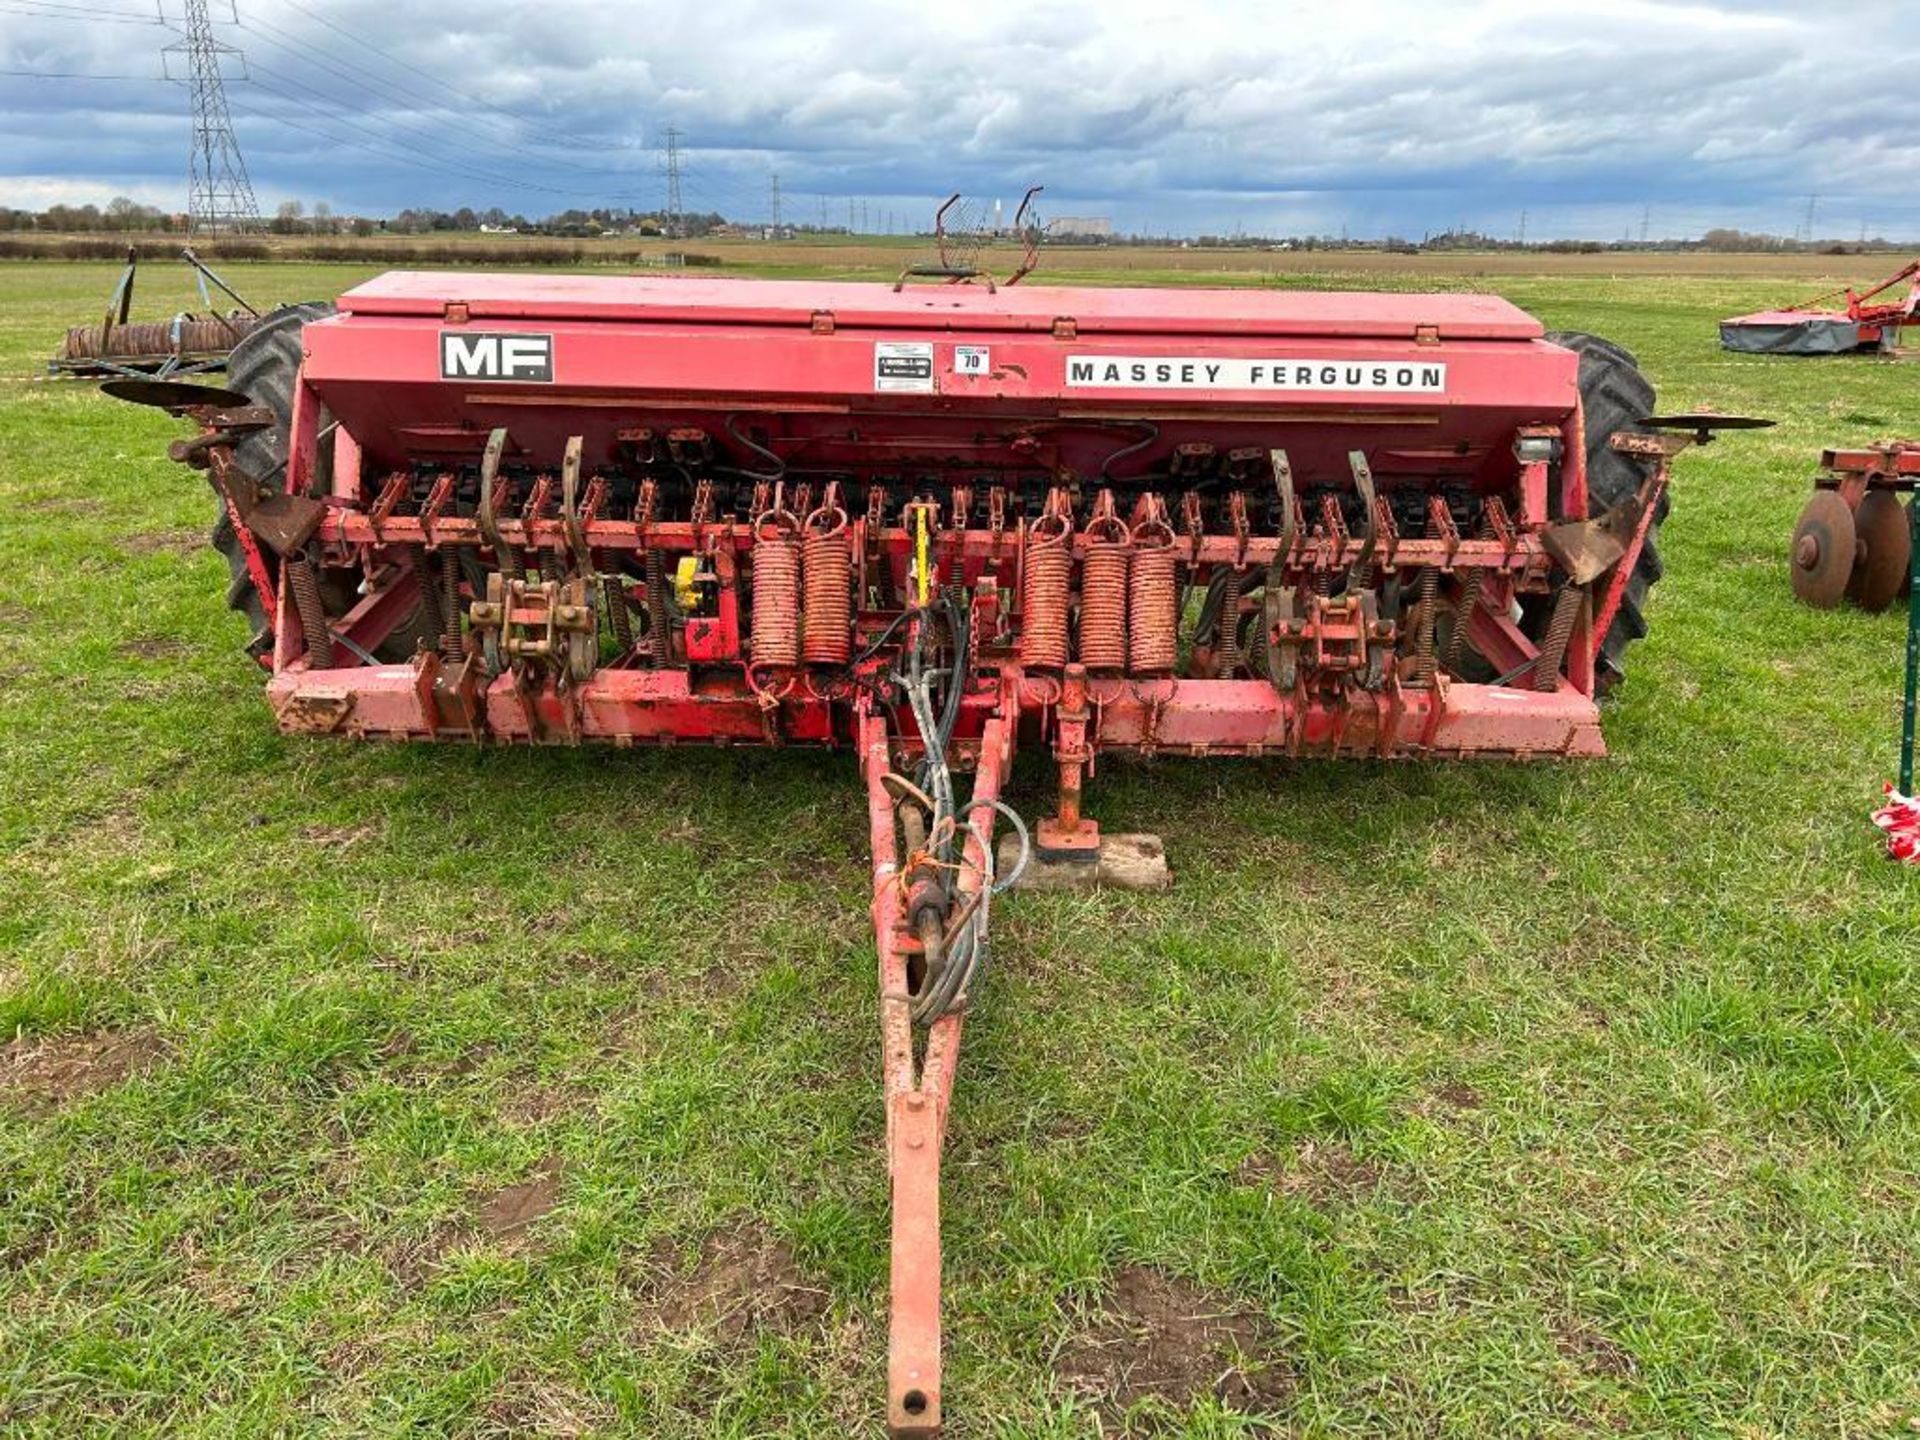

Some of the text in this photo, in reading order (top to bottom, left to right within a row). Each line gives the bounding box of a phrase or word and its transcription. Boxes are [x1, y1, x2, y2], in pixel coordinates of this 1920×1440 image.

[964, 355, 980, 368] 70
[1071, 363, 1440, 387] MASSEY FERGUSON
